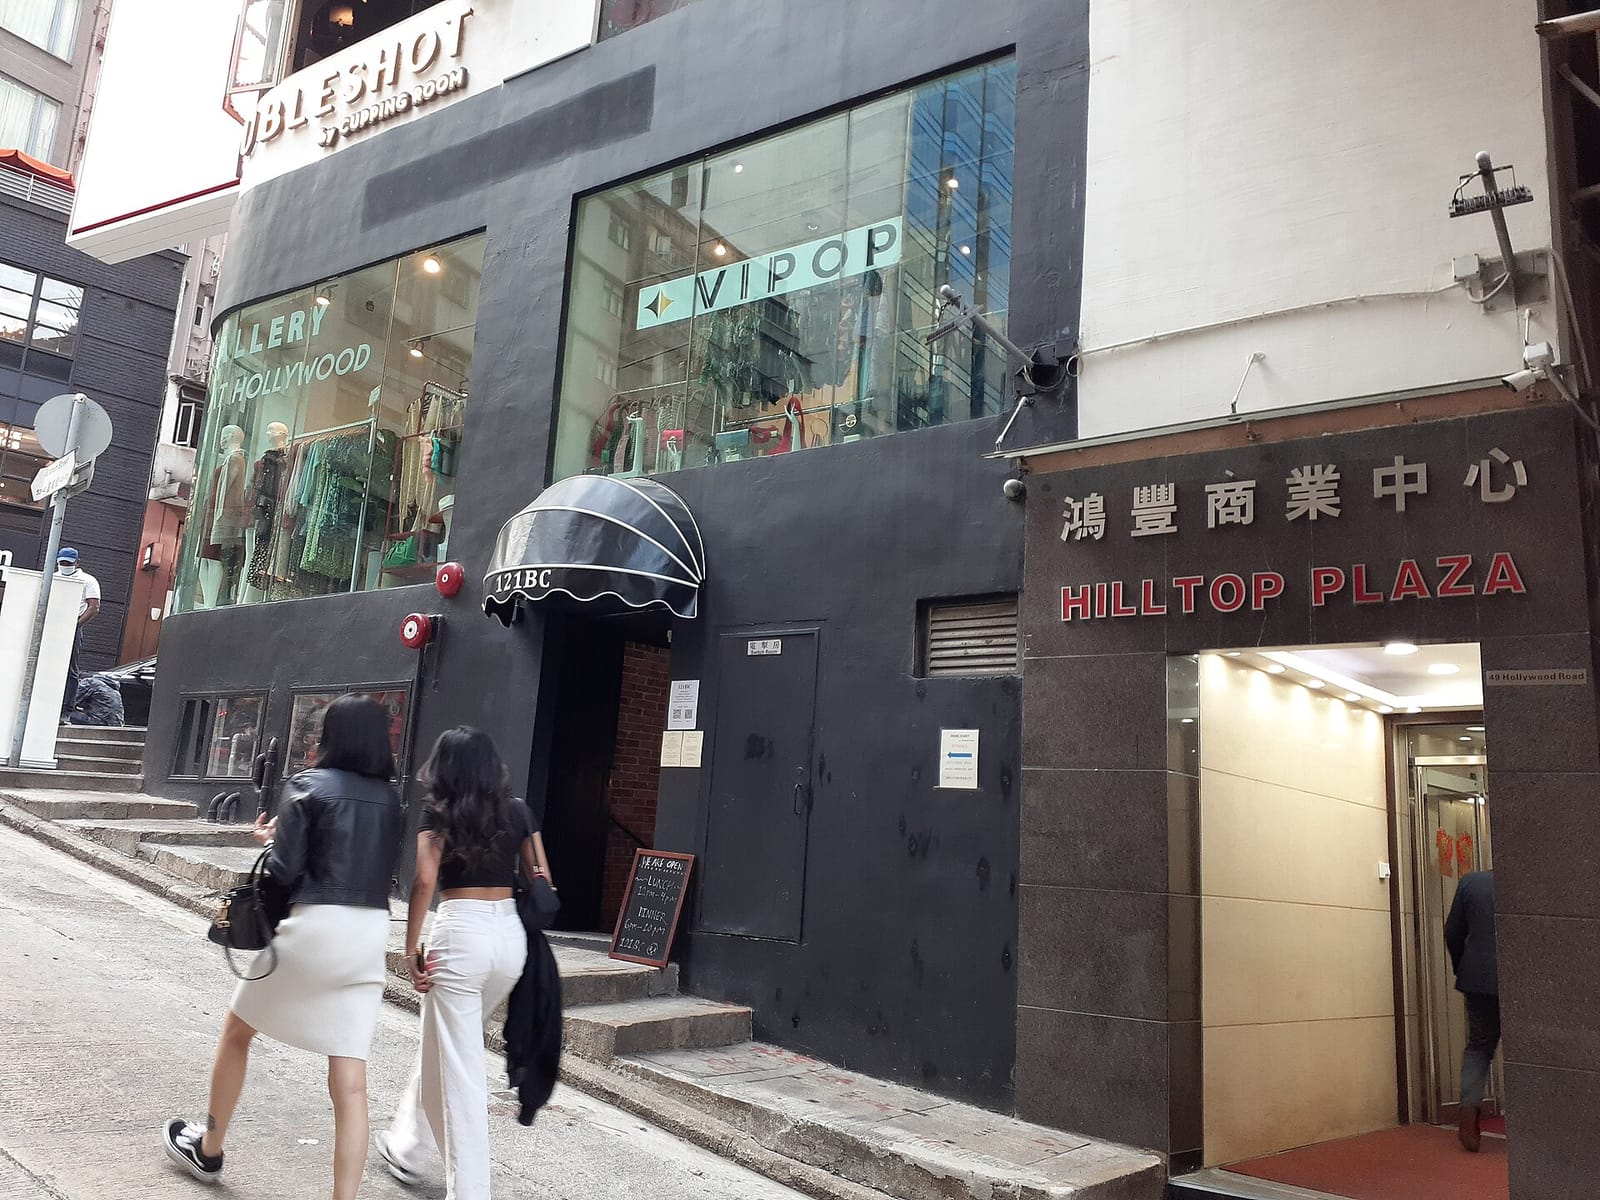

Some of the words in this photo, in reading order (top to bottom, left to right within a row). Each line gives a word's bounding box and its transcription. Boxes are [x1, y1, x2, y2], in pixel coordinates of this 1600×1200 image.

[341, 91, 414, 137] CUPPING
[411, 66, 469, 107] ROOM
[696, 223, 897, 310] VIPOP
[231, 343, 371, 404] HOLLYWOOD
[1060, 447, 1527, 542] 鴻豐商業中心
[495, 569, 552, 593] 121BC
[1311, 551, 1526, 607] PLAZA
[1502, 672, 1556, 682] Hollywood
[1558, 671, 1584, 680] Road
